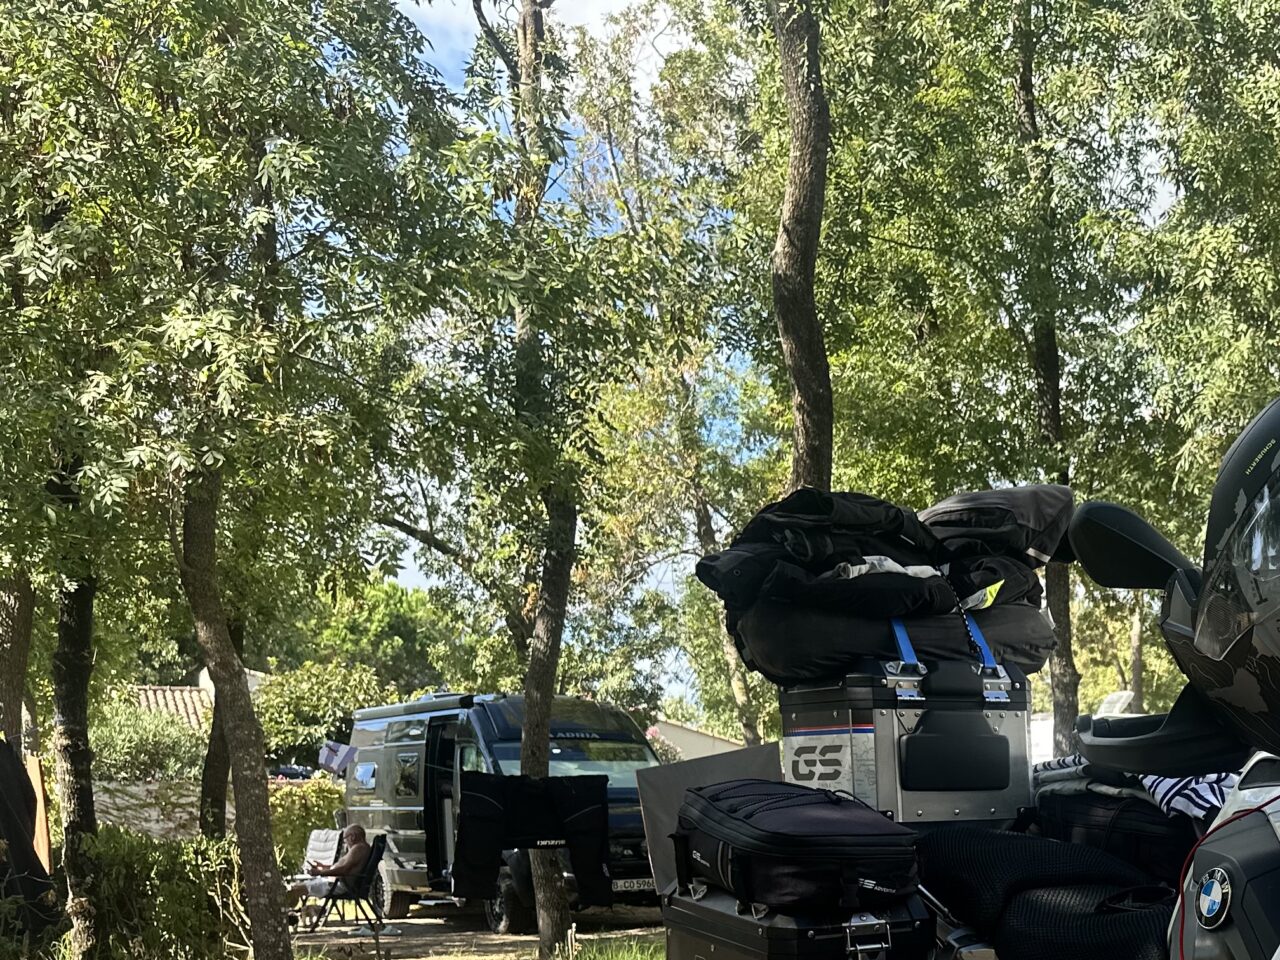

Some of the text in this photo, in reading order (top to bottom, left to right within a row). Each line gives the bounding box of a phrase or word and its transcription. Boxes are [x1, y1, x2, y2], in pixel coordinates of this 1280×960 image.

[1245, 439, 1276, 475] SCHUBERTH
[792, 745, 842, 781] GS
[1203, 870, 1229, 893] BMW
